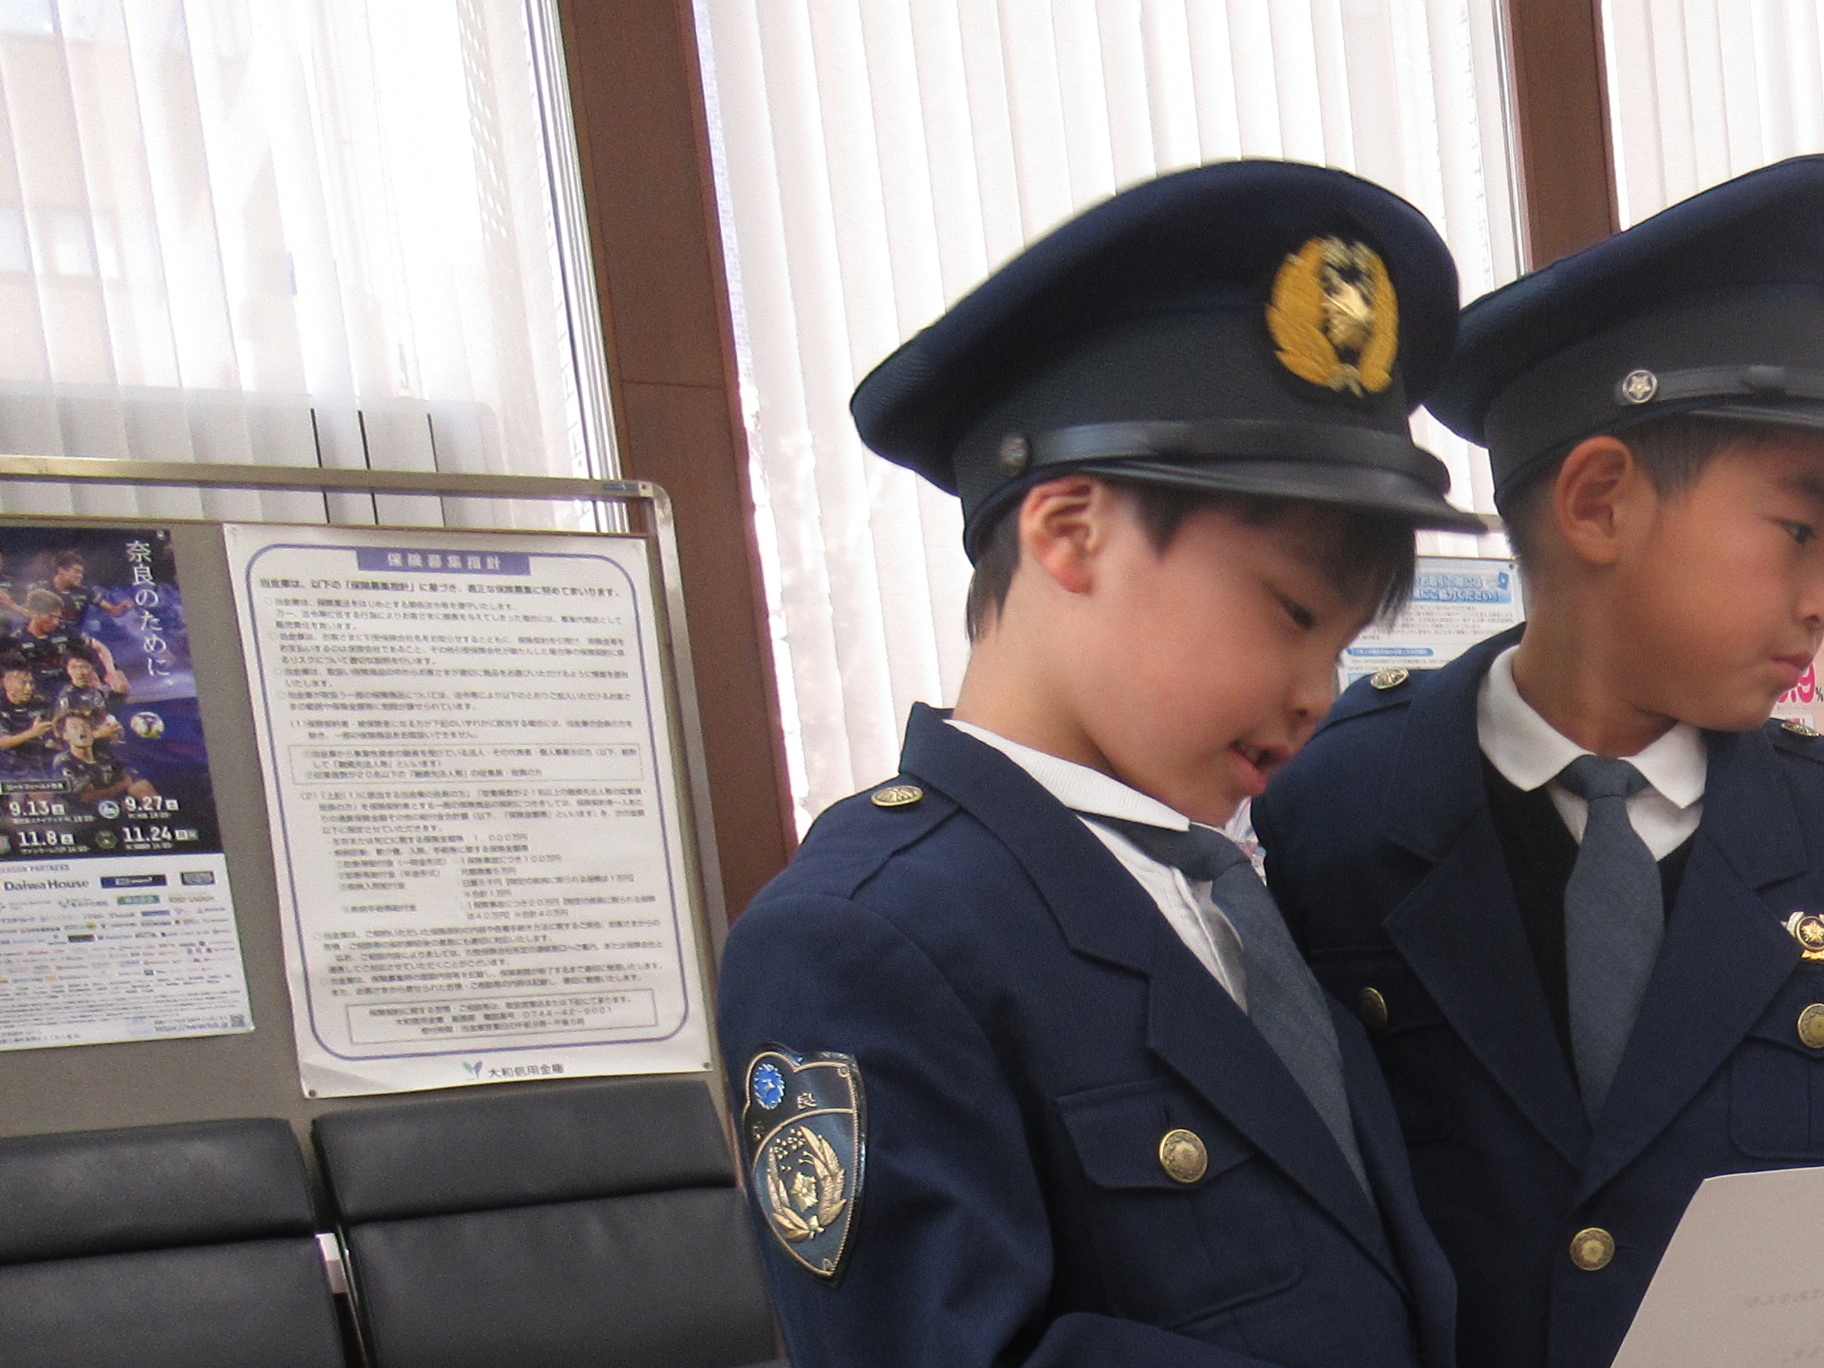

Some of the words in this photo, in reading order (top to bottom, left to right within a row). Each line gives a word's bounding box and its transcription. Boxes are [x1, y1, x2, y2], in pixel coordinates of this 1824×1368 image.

[1776, 662, 1816, 704] .9
[125, 795, 163, 812] 9.27
[19, 830, 58, 847] 11.8
[122, 826, 173, 843] 11.24
